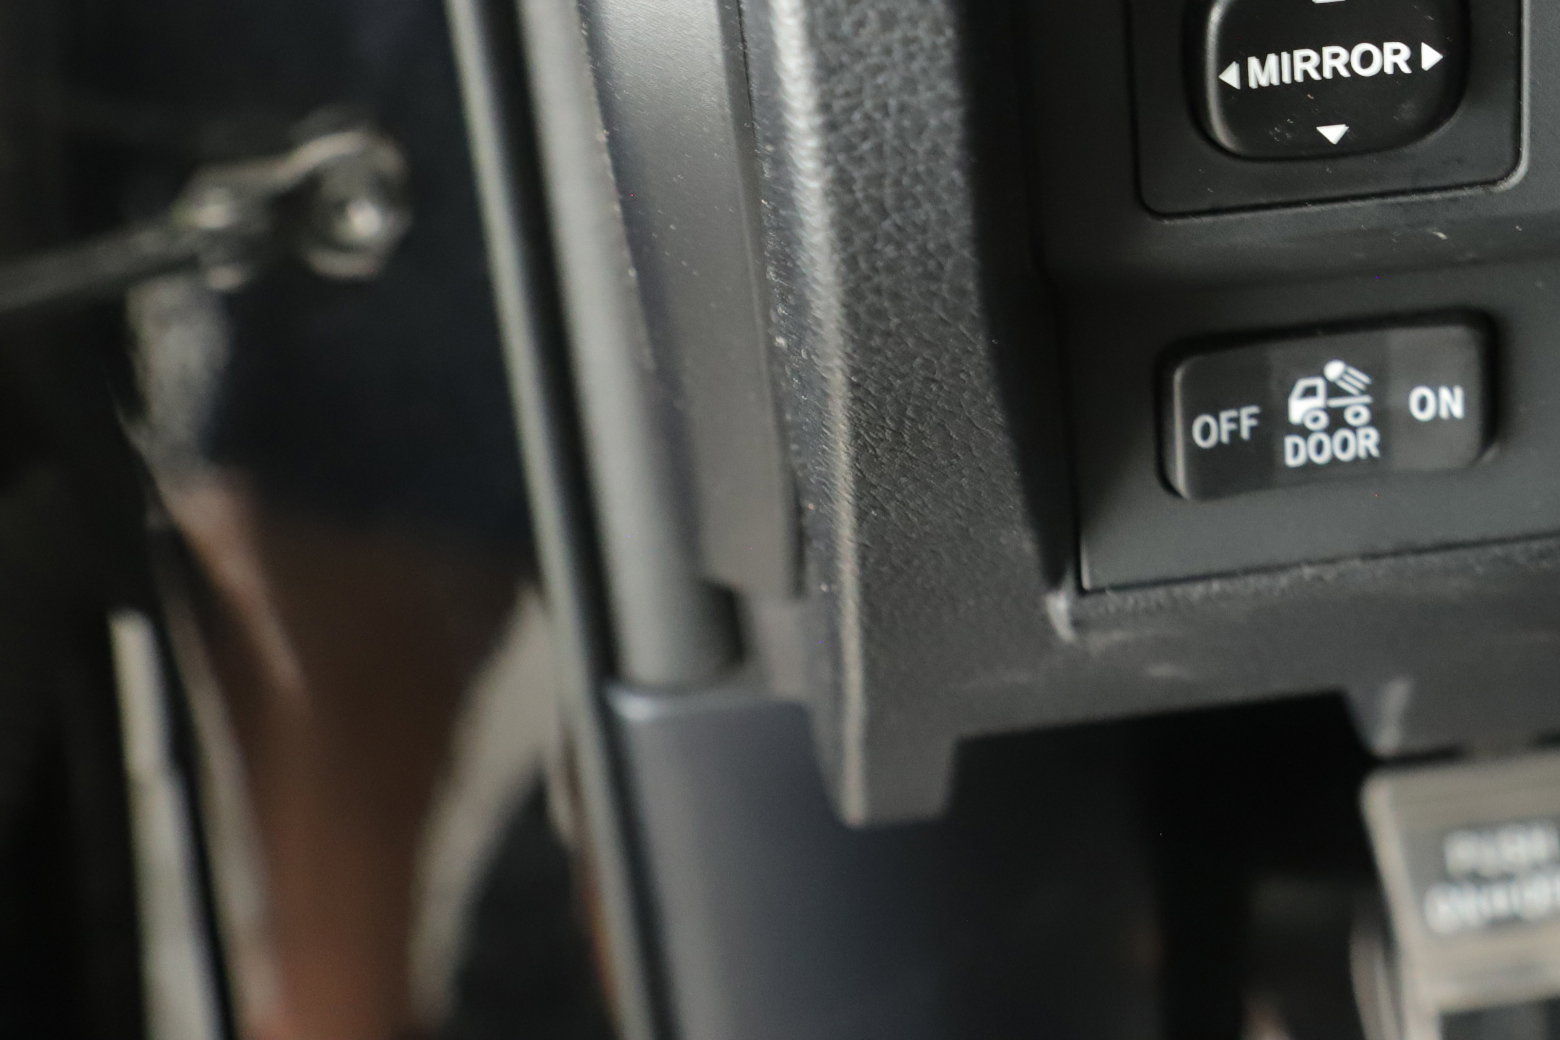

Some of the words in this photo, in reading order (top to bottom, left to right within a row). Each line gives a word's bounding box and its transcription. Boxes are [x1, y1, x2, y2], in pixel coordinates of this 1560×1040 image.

[1247, 41, 1412, 89] MIRROR
[1408, 385, 1465, 421] ON
[1192, 405, 1261, 448] OFF
[1284, 426, 1381, 468] DOOR
